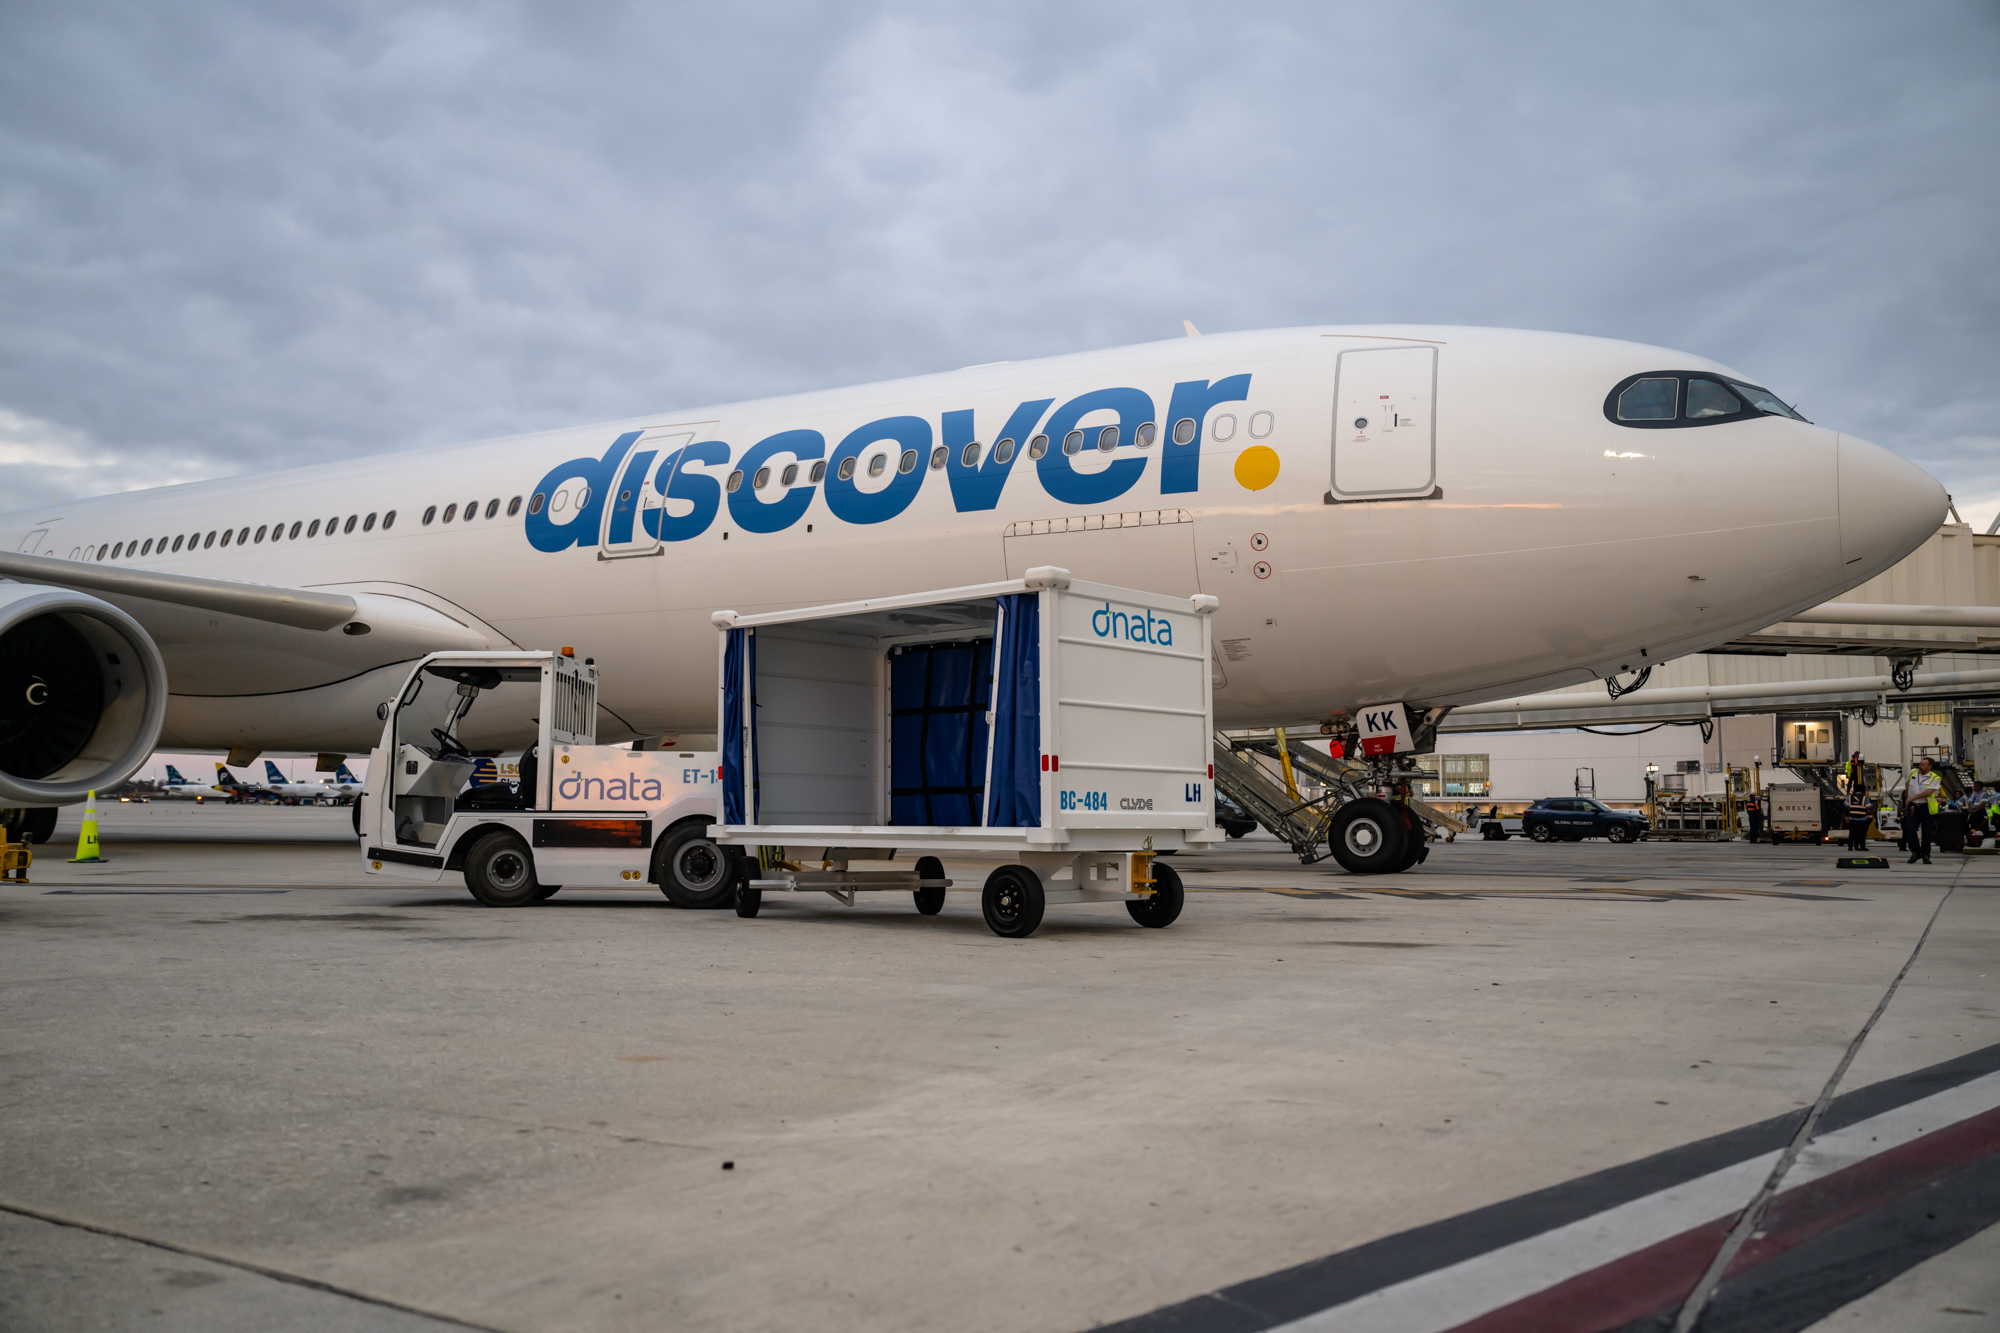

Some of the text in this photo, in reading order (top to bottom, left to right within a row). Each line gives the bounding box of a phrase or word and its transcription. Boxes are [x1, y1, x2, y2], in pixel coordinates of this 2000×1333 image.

[1092, 602, 1173, 646] dnata
[1365, 710, 1398, 733] KK
[559, 772, 662, 801] dnata
[683, 769, 719, 784] ET-1
[1060, 790, 1108, 811] BC-484
[1185, 783, 1201, 802] LH
[1120, 798, 1153, 810] CLYDE
